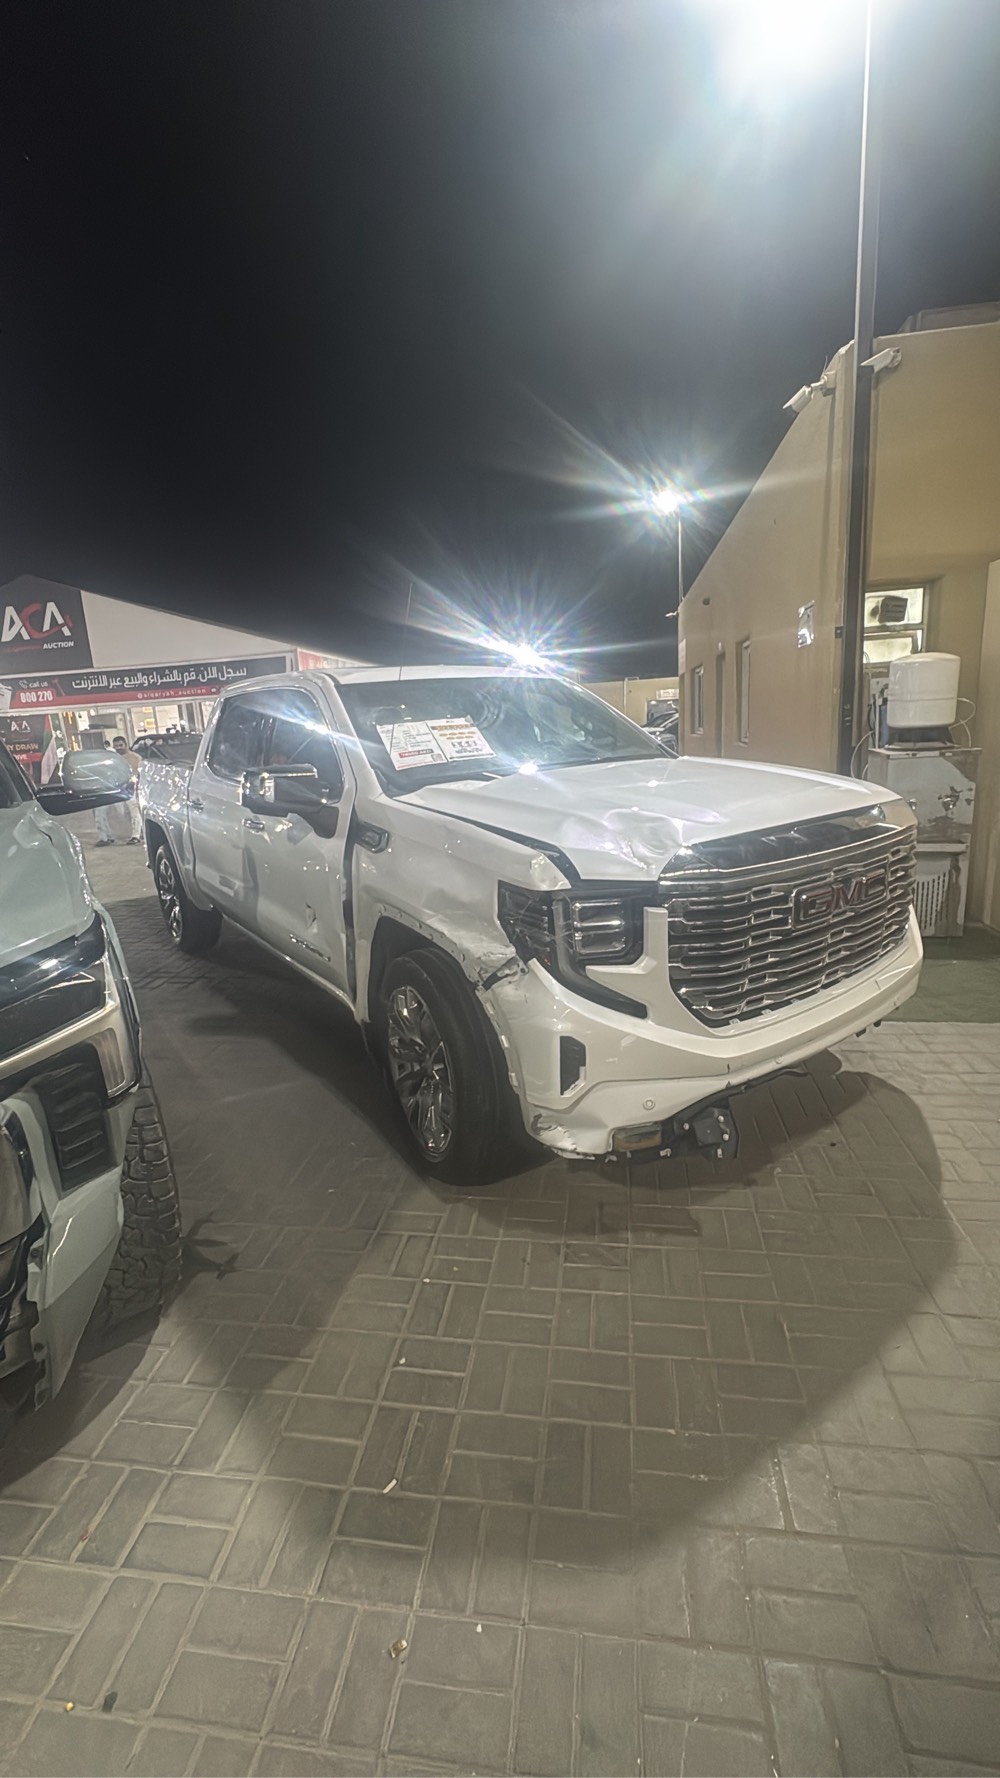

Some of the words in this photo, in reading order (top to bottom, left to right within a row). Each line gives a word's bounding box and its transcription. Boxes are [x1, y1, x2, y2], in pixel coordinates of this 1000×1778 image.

[42, 641, 74, 650] AUCTION
[123, 672, 147, 689] والبيع
[149, 669, 182, 686] بالشراء
[184, 668, 196, 686] قم
[218, 666, 247, 681] سجل
[72, 675, 108, 691] الانترنت
[109, 676, 122, 689] عبر
[20, 692, 37, 703] 800
[38, 690, 53, 702] 270
[15, 743, 39, 751] DRAW
[799, 869, 885, 920] GMC
